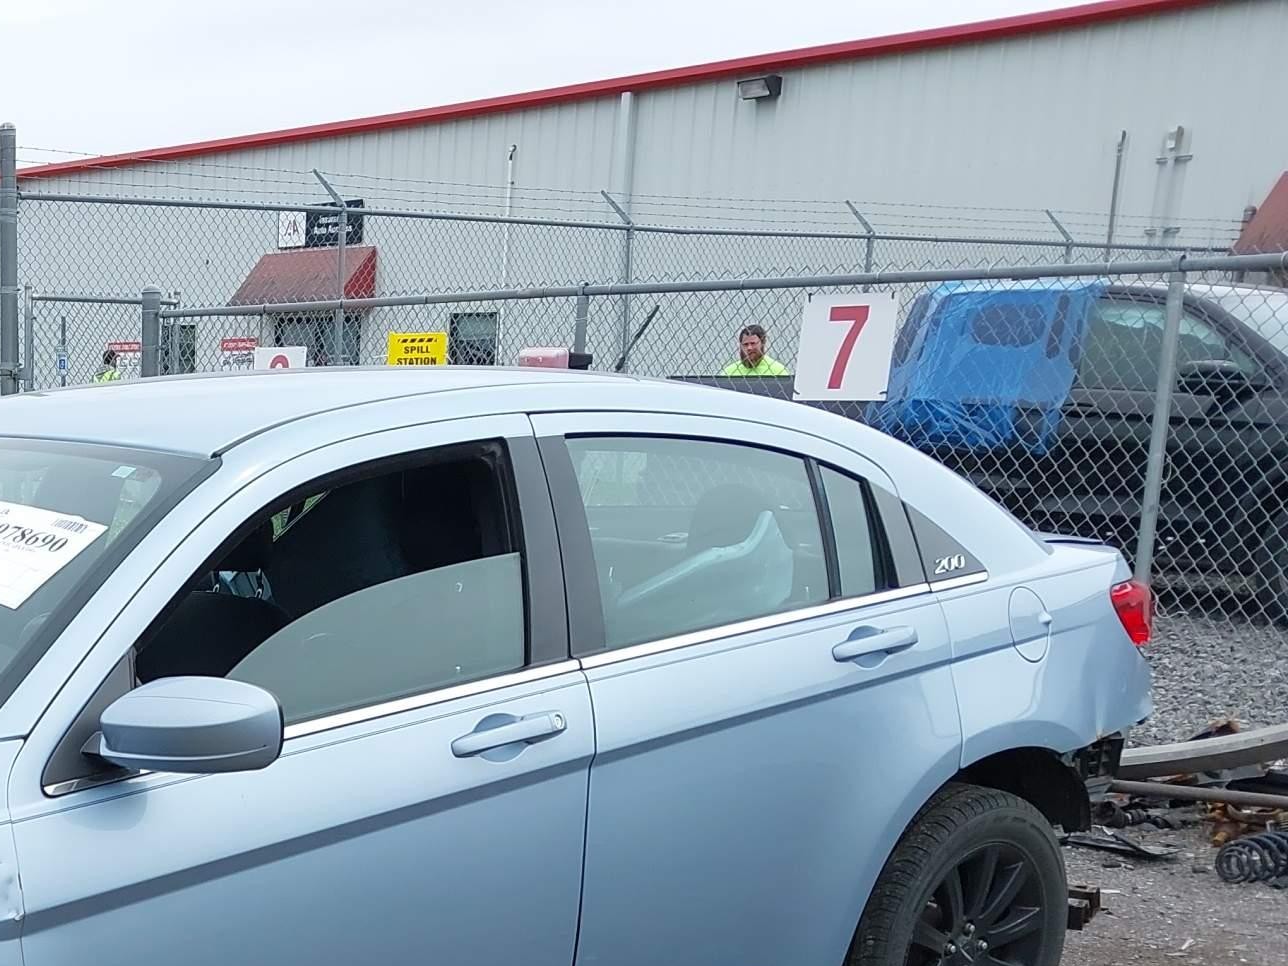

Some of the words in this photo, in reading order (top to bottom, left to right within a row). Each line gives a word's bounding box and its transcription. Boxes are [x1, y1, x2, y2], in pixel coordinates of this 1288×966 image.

[404, 345, 431, 354] SPILL
[827, 305, 870, 389] 7
[396, 356, 437, 365] STATION
[934, 553, 966, 575] 200
